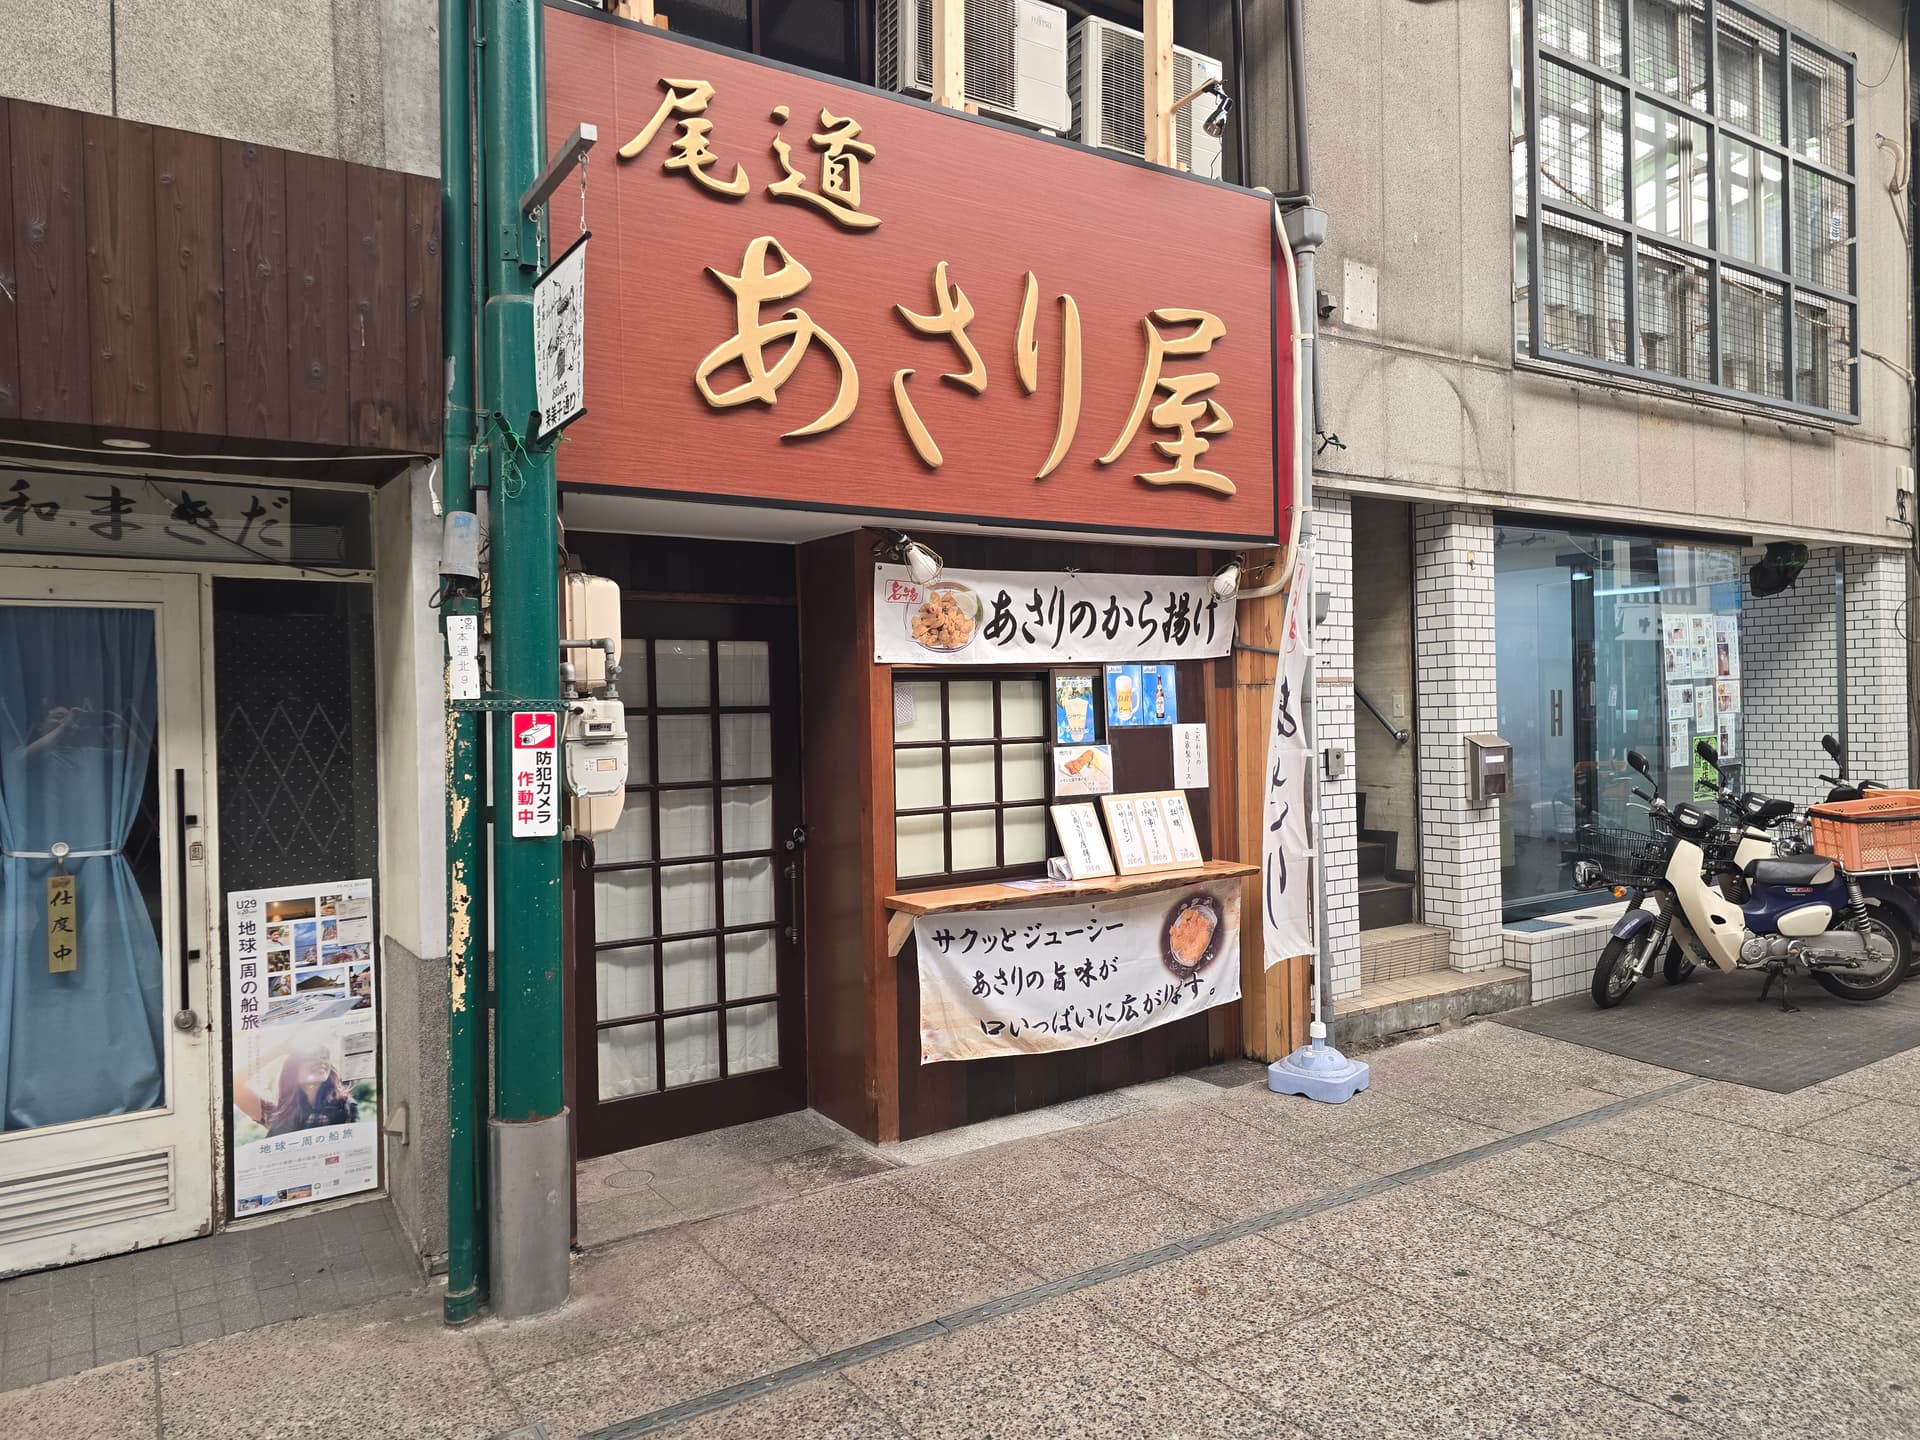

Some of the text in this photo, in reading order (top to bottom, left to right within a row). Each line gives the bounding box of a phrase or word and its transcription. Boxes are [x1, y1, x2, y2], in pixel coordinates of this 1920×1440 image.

[618, 78, 882, 229] 尾道
[695, 236, 1236, 498] あさり屋
[983, 585, 1218, 650] あさりのから揚げ
[518, 771, 534, 824] 作動中
[536, 751, 552, 824] 防犯カメラ
[50, 890, 73, 961] 仕度中
[236, 899, 257, 910] U29
[931, 918, 1124, 955] サクッとジューシー
[237, 920, 260, 1031] 地球一周の船旅
[971, 956, 1119, 998] あさりの旨味が
[259, 1127, 353, 1154] 地球一周の船旅
